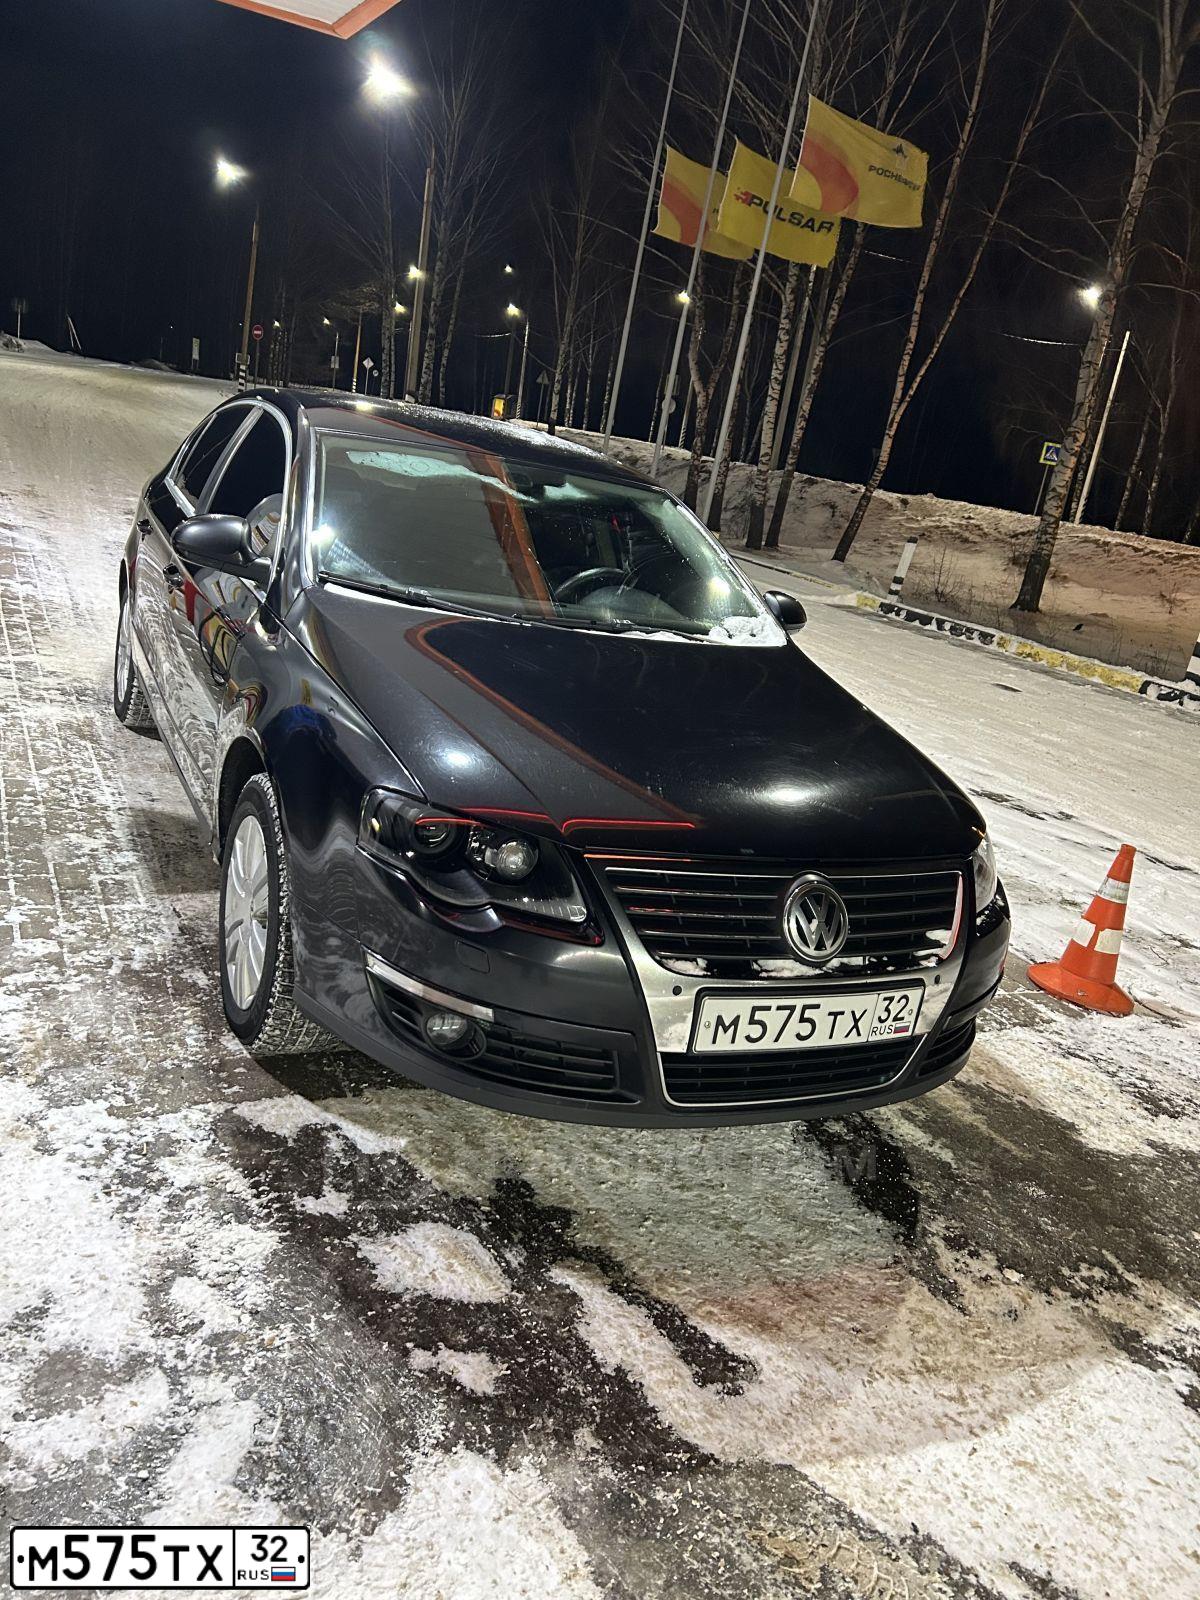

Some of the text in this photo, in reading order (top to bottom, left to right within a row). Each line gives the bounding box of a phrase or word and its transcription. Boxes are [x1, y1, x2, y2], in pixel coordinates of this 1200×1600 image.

[749, 193, 835, 234] PULSAR
[877, 994, 910, 1024] 32
[871, 1024, 893, 1037] RUS
